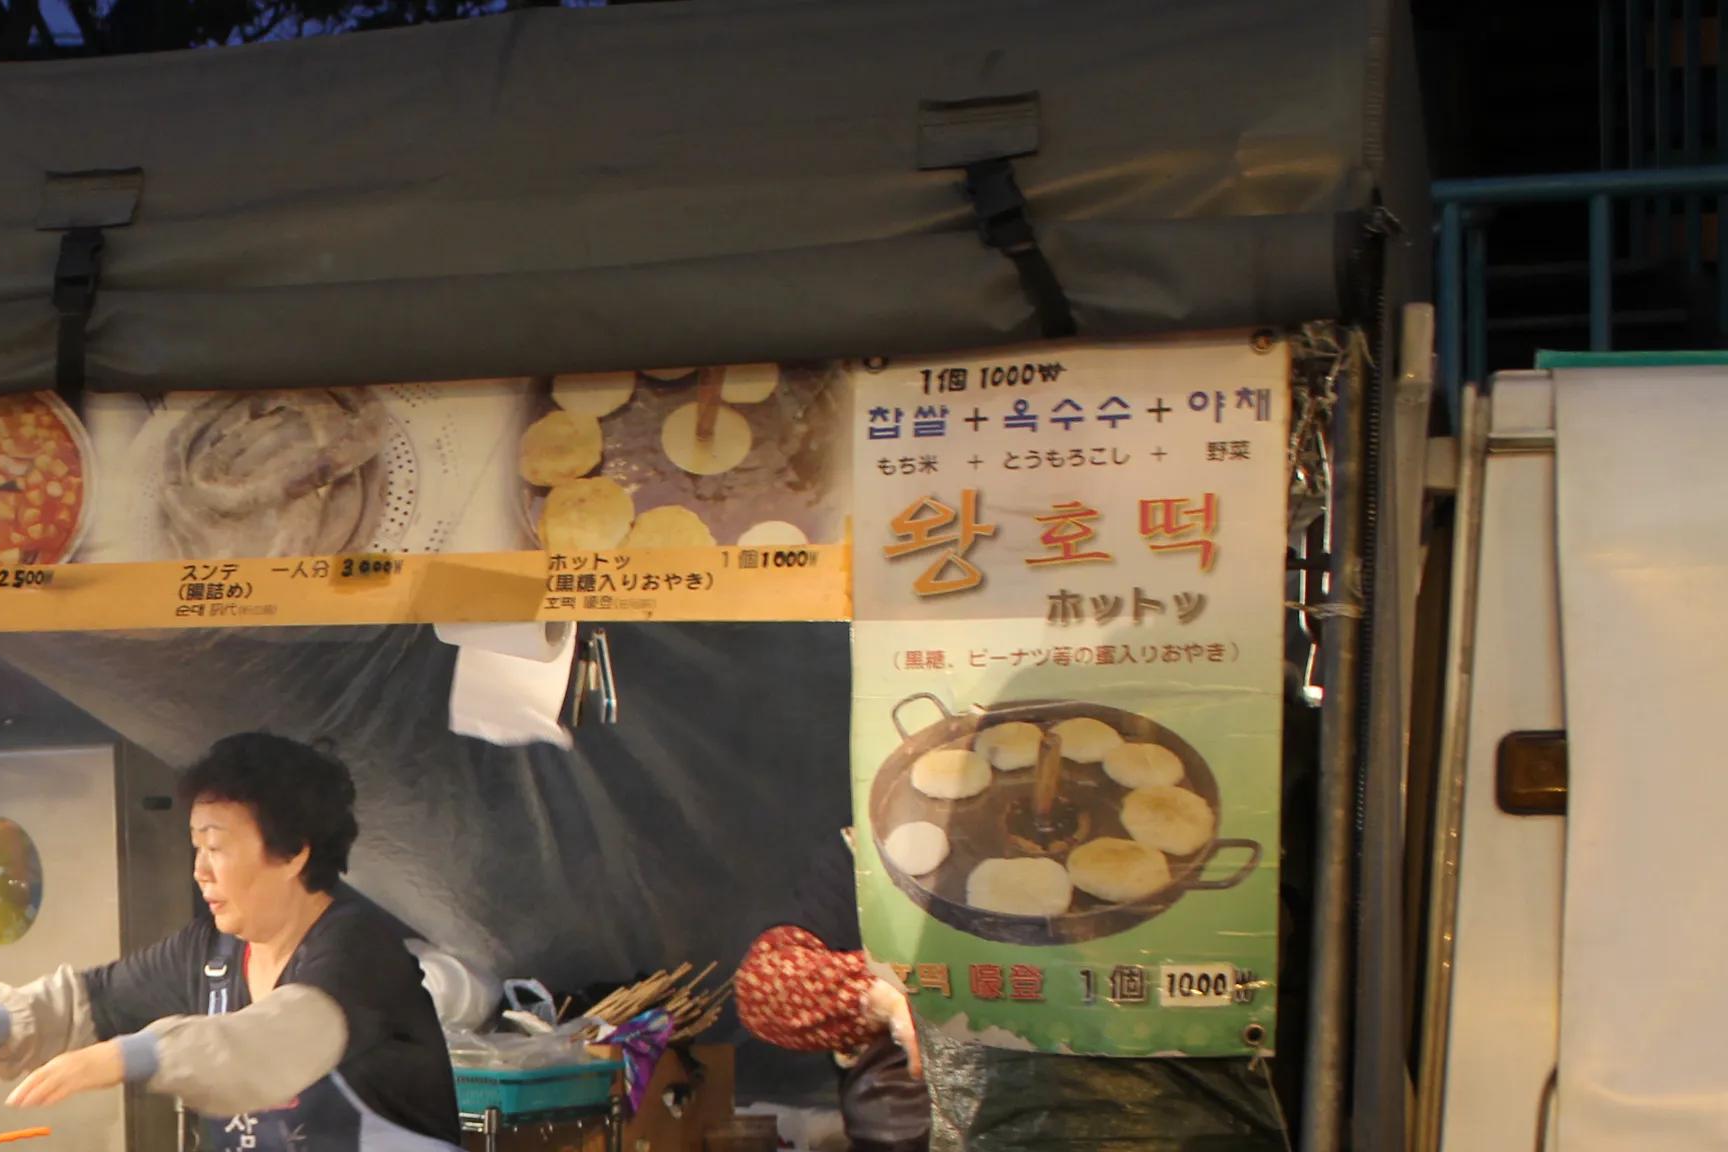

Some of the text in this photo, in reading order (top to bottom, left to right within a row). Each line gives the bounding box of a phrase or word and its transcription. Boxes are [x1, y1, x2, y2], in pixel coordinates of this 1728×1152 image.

[867, 402, 951, 441] 찹쌀
[1003, 395, 1134, 433] 옥수수
[1187, 386, 1272, 424] 야채
[877, 451, 940, 476] もち米
[1002, 446, 1132, 471] とうもろこし
[1205, 440, 1253, 462] 野菜
[181, 563, 239, 582] スンデ
[271, 560, 330, 579] 一人分
